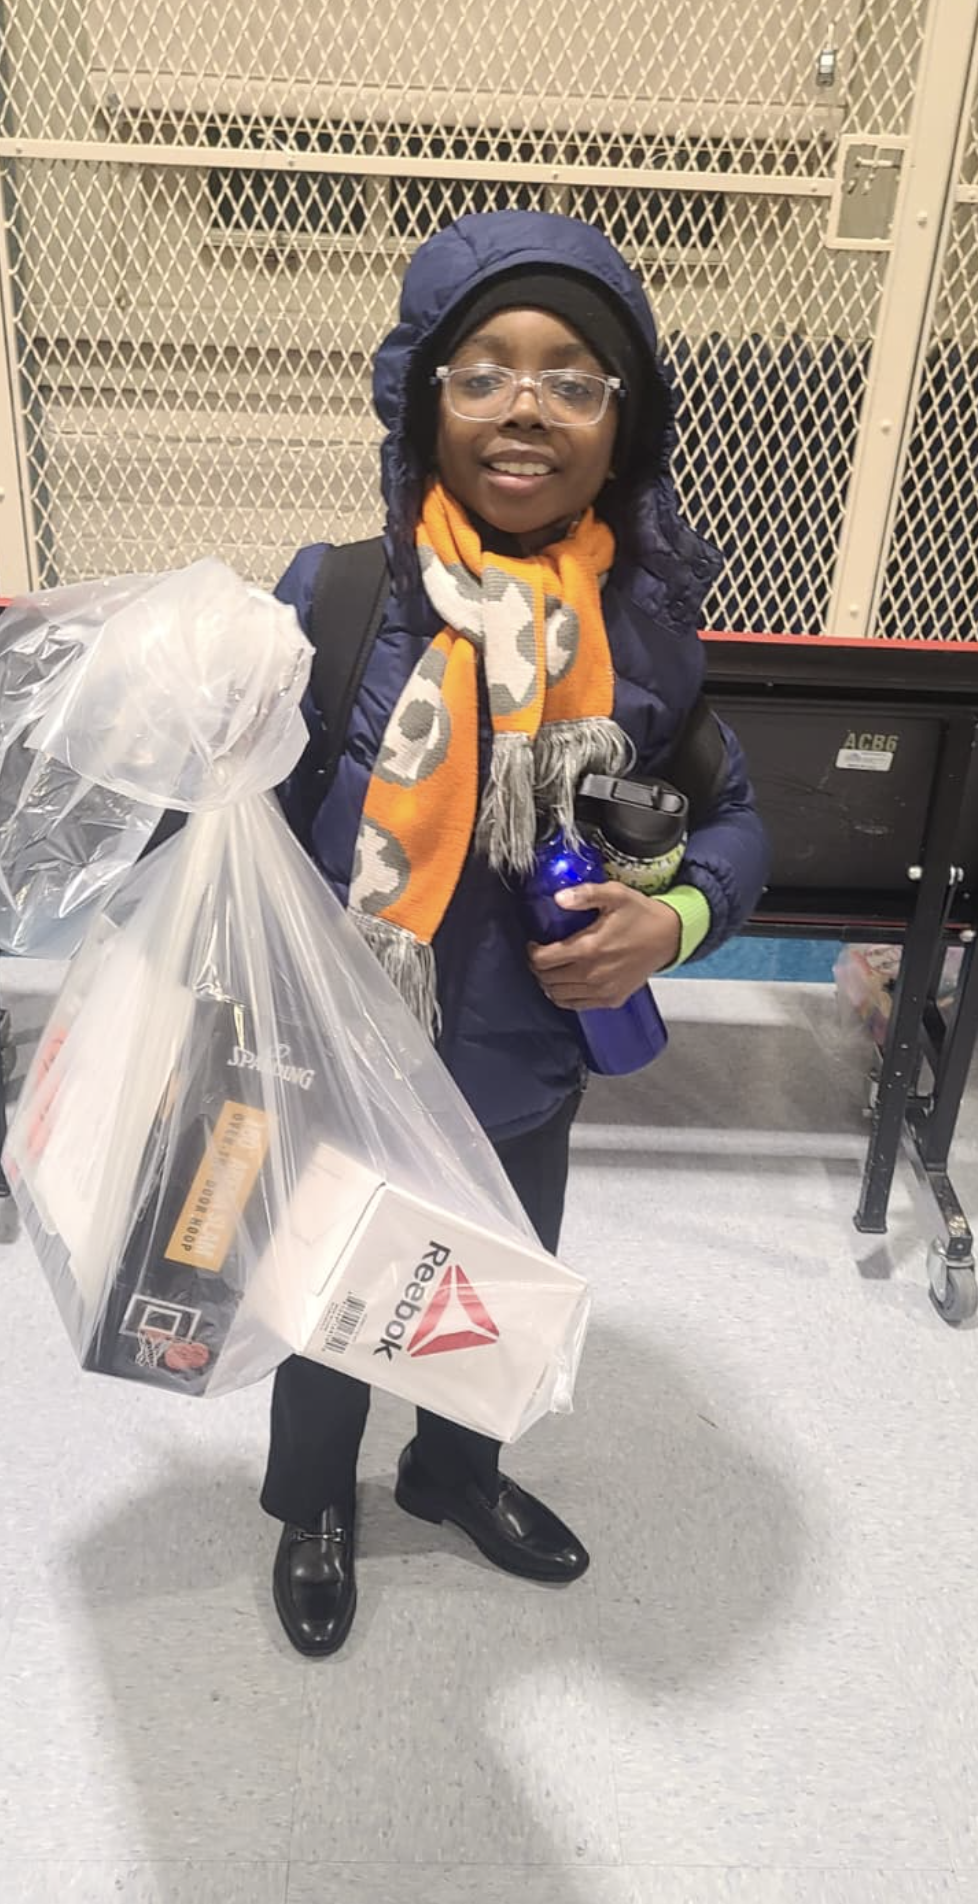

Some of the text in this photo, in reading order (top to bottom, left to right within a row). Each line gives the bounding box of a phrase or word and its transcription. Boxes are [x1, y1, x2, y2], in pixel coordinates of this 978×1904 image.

[843, 732, 899, 751] ACB6
[227, 1045, 315, 1090] SPADING
[180, 1216, 204, 1252] HOOP
[373, 1240, 451, 1361] Reebok
